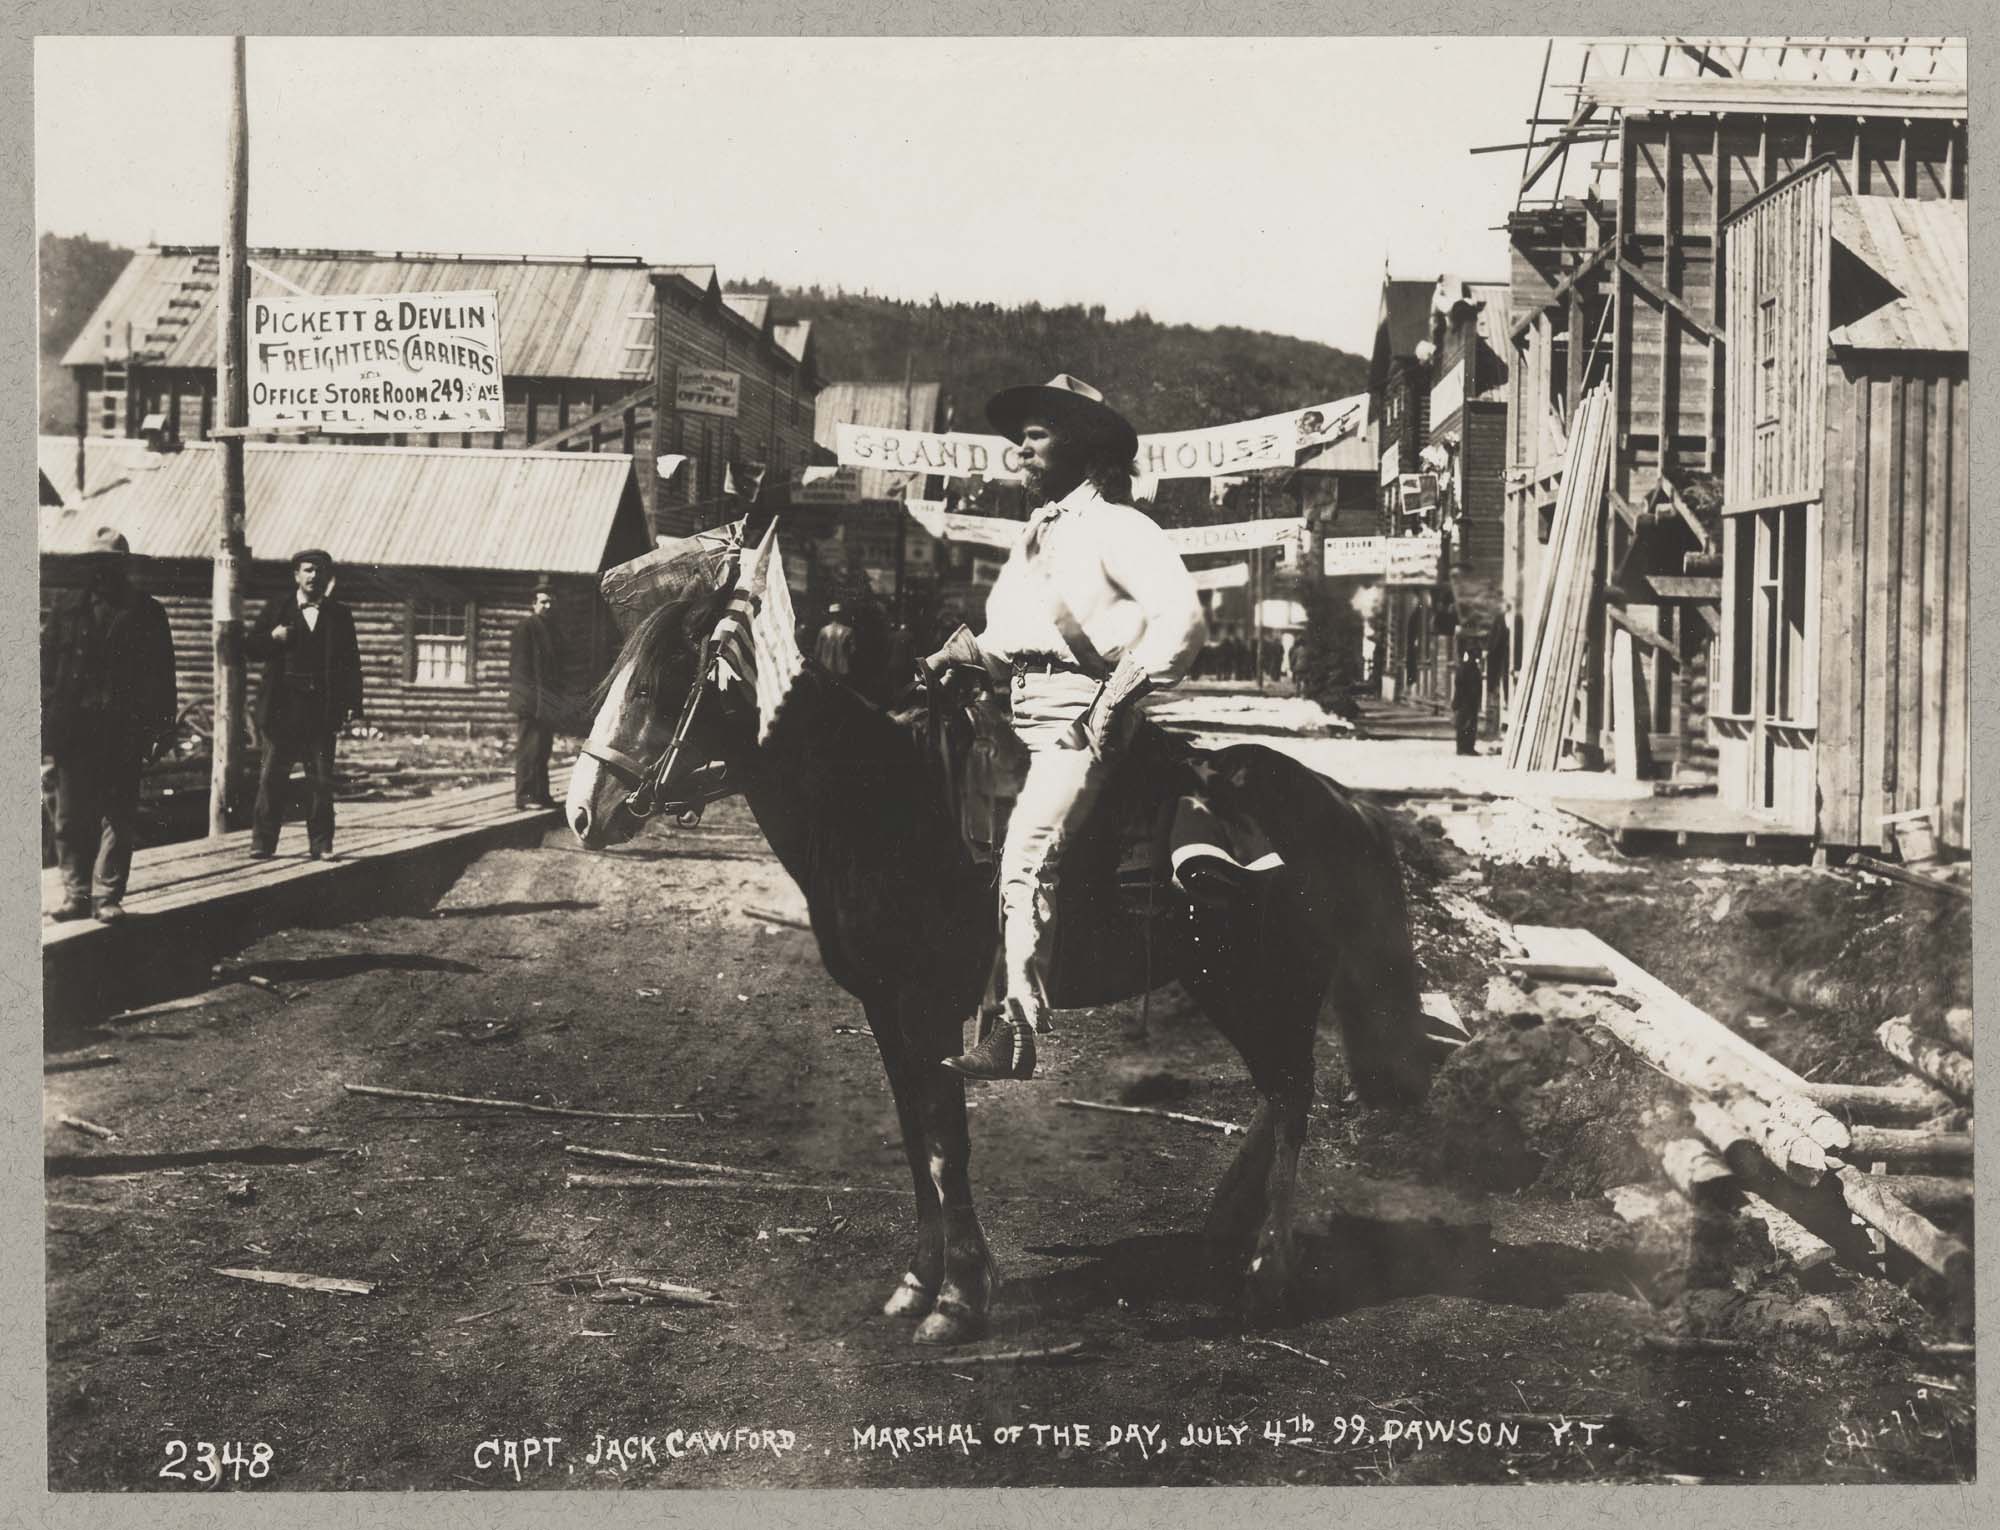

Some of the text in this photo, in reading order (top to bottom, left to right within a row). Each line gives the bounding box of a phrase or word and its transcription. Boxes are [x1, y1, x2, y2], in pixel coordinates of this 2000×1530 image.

[255, 302, 485, 334] PICKETT & DEVLIN
[258, 333, 494, 375] FREIGHTERS CARRIERS
[253, 382, 318, 405] OFFICE
[325, 383, 381, 404] STORE
[383, 381, 427, 403] ROOM
[431, 378, 463, 402] 249
[855, 434, 988, 472] GRAND
[1147, 434, 1281, 472] HOUSE
